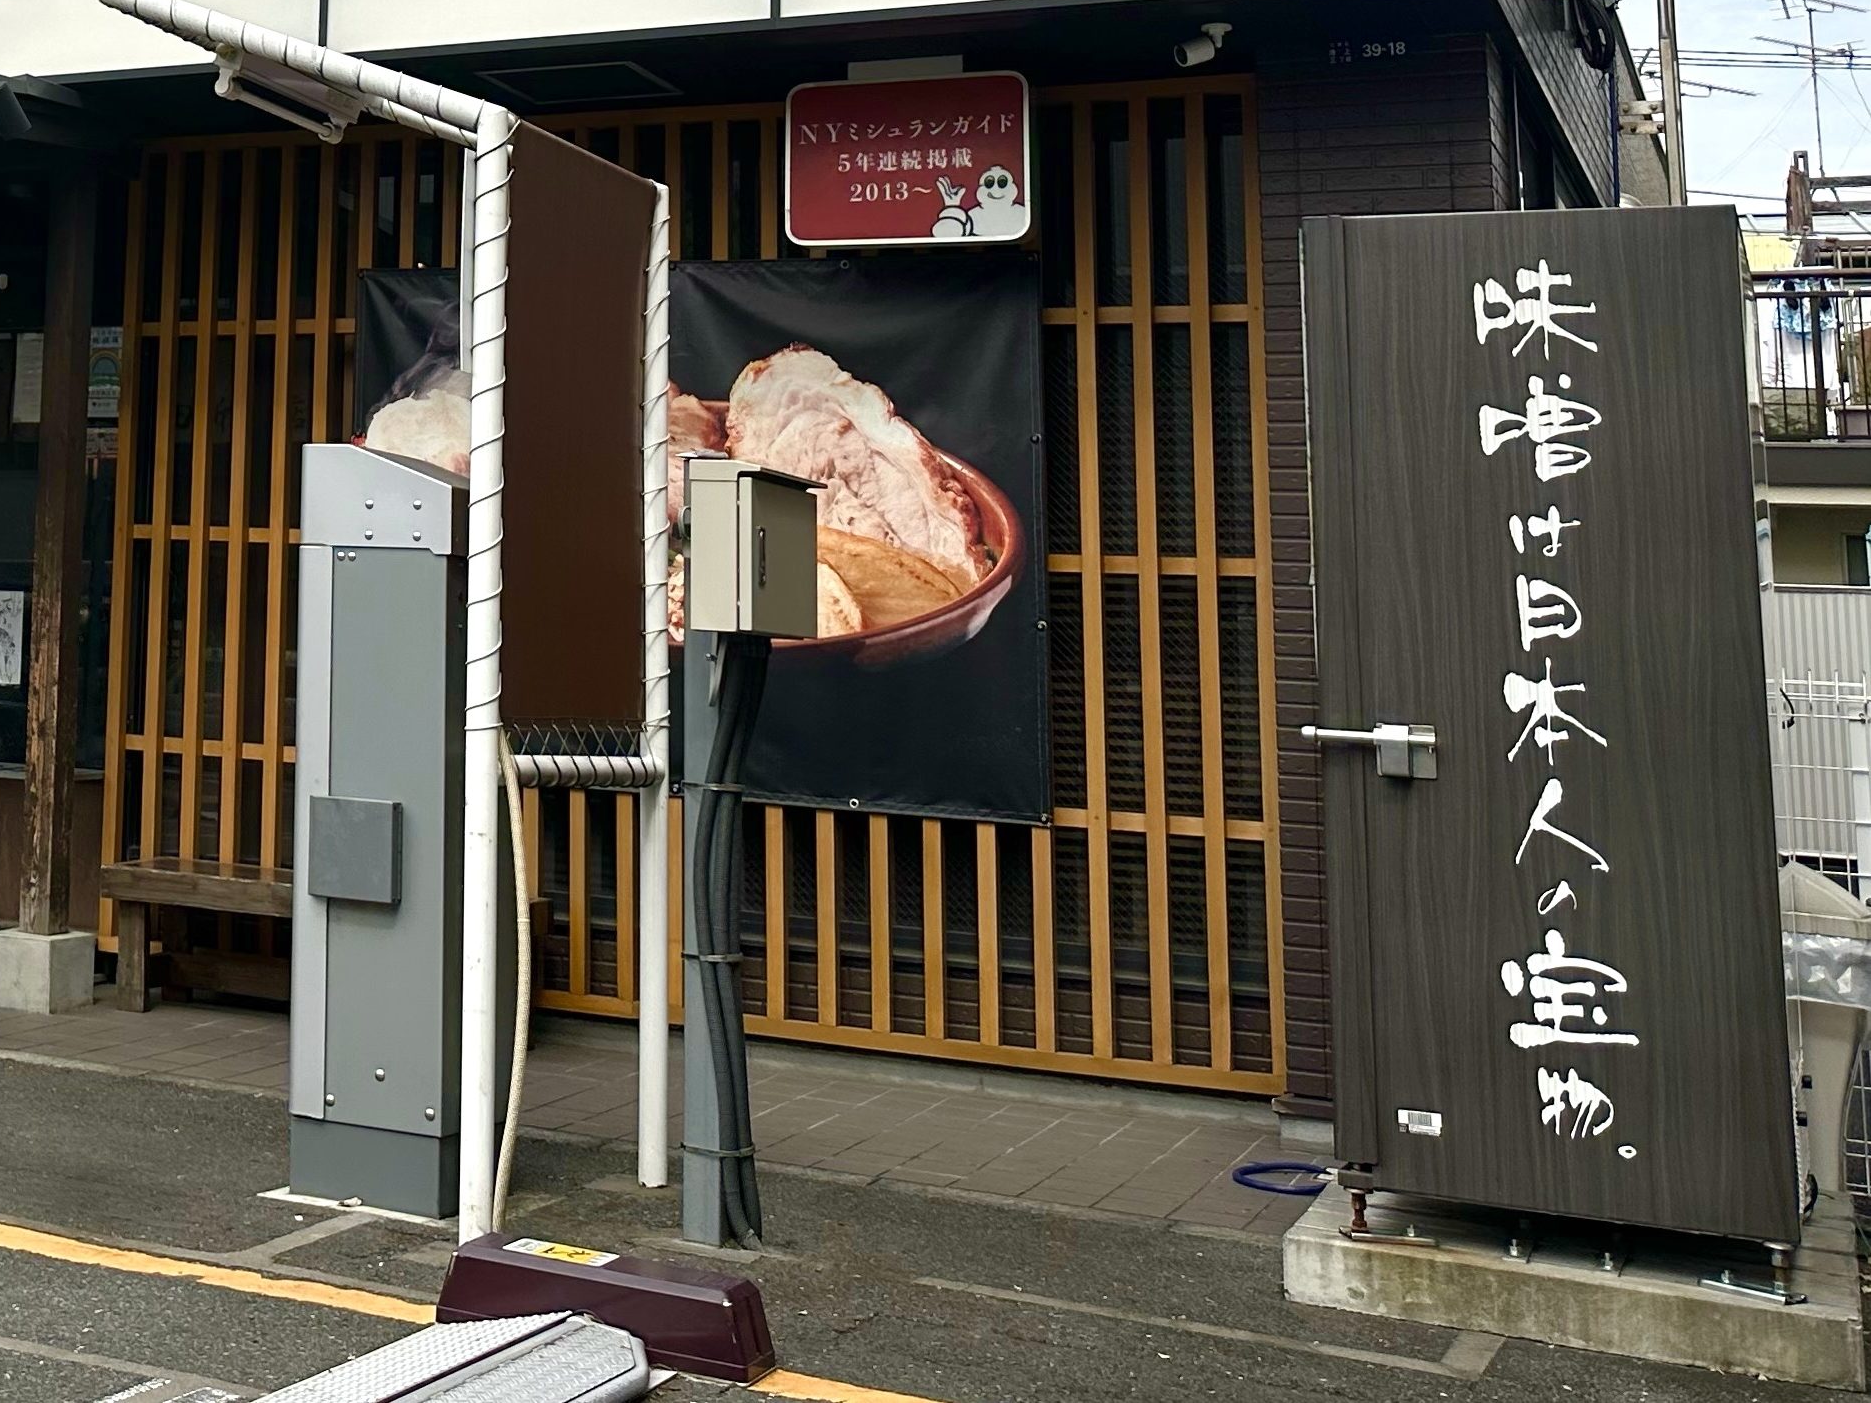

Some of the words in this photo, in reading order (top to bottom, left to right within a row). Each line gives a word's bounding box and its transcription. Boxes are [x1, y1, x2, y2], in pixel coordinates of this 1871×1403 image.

[1361, 41, 1406, 58] 39-18
[837, 147, 974, 173] 5年連続掲載
